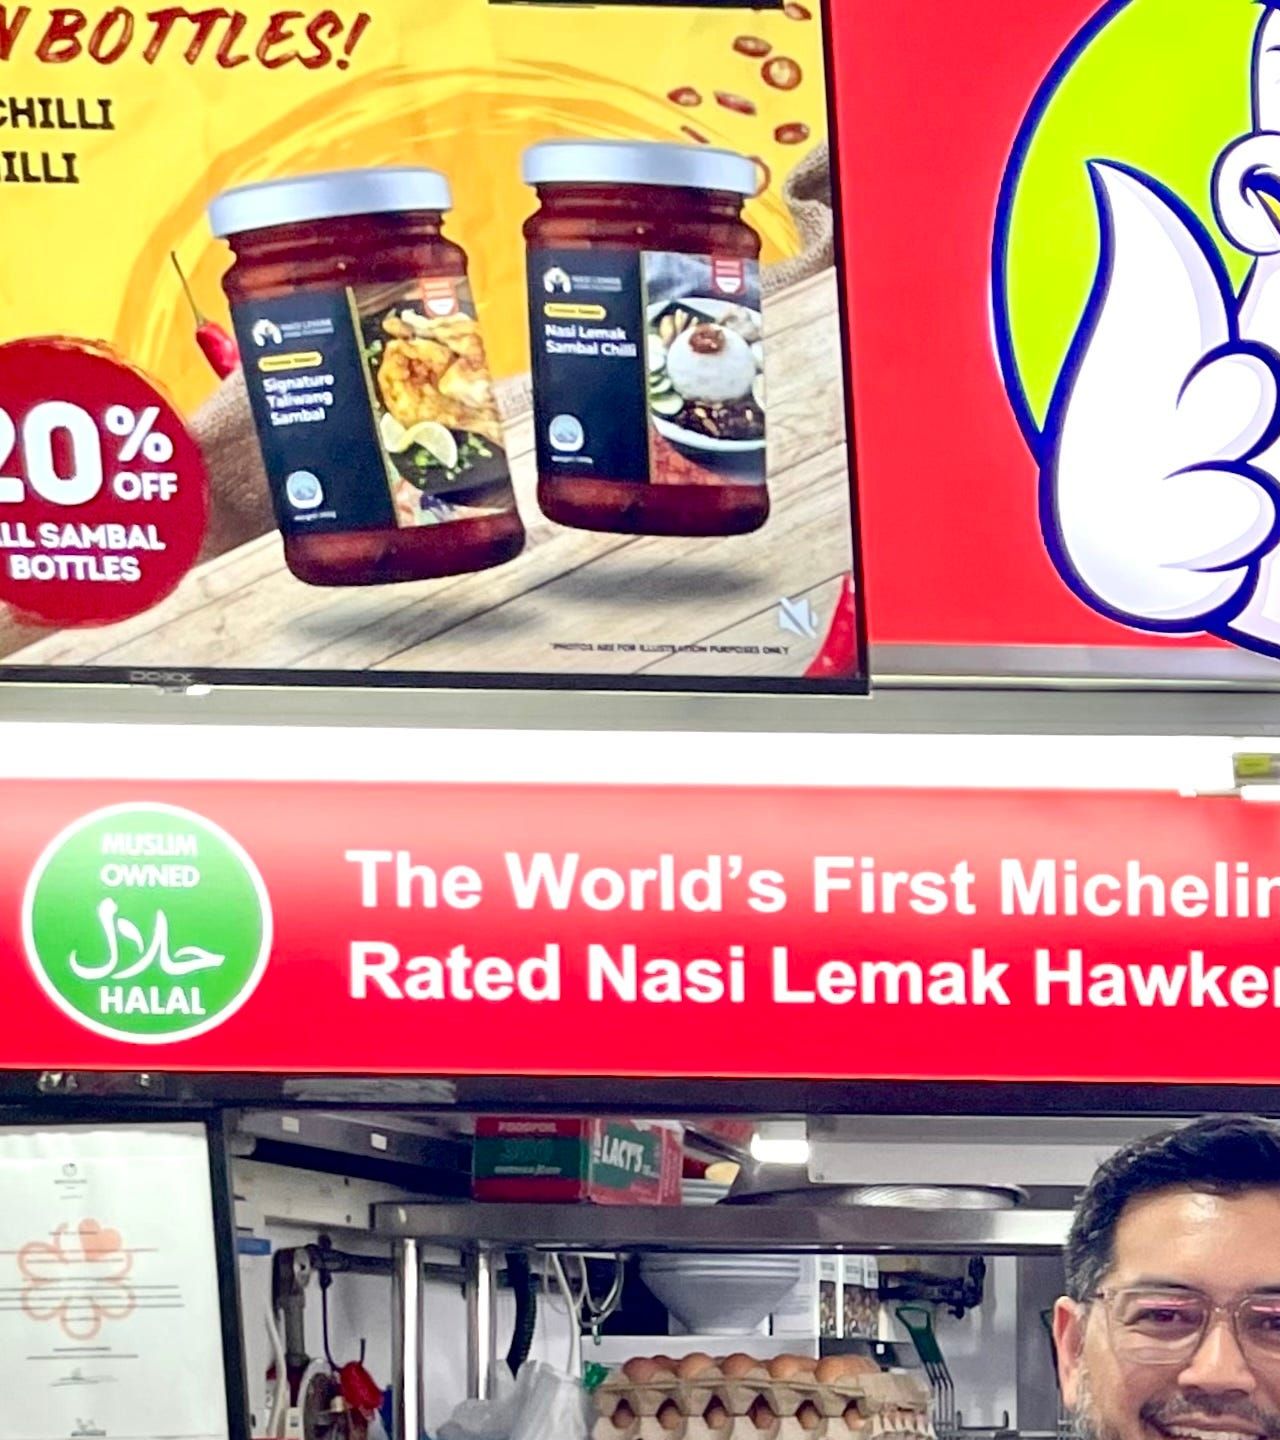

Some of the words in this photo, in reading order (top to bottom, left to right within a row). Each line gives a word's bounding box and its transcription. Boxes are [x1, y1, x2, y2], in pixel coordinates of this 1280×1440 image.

[36, 7, 371, 70] BOTTLES!
[544, 323, 576, 338] Nasi
[578, 325, 627, 341] Lemak
[546, 339, 599, 355] Sambal
[263, 374, 335, 394] Signature
[266, 391, 334, 409] Taliwang
[270, 407, 326, 426] Sambal
[113, 471, 178, 501] OFF
[39, 523, 166, 551] SAMBAL
[9, 555, 141, 582] BOTTLES
[101, 832, 198, 858] MUSLIM
[100, 862, 201, 889] OWNED
[345, 849, 483, 910] The
[812, 855, 976, 916] First
[350, 940, 561, 1002] Rated
[588, 944, 745, 1003] Nasi
[771, 946, 1011, 1006] Lemak
[99, 985, 207, 1017] HALAL
